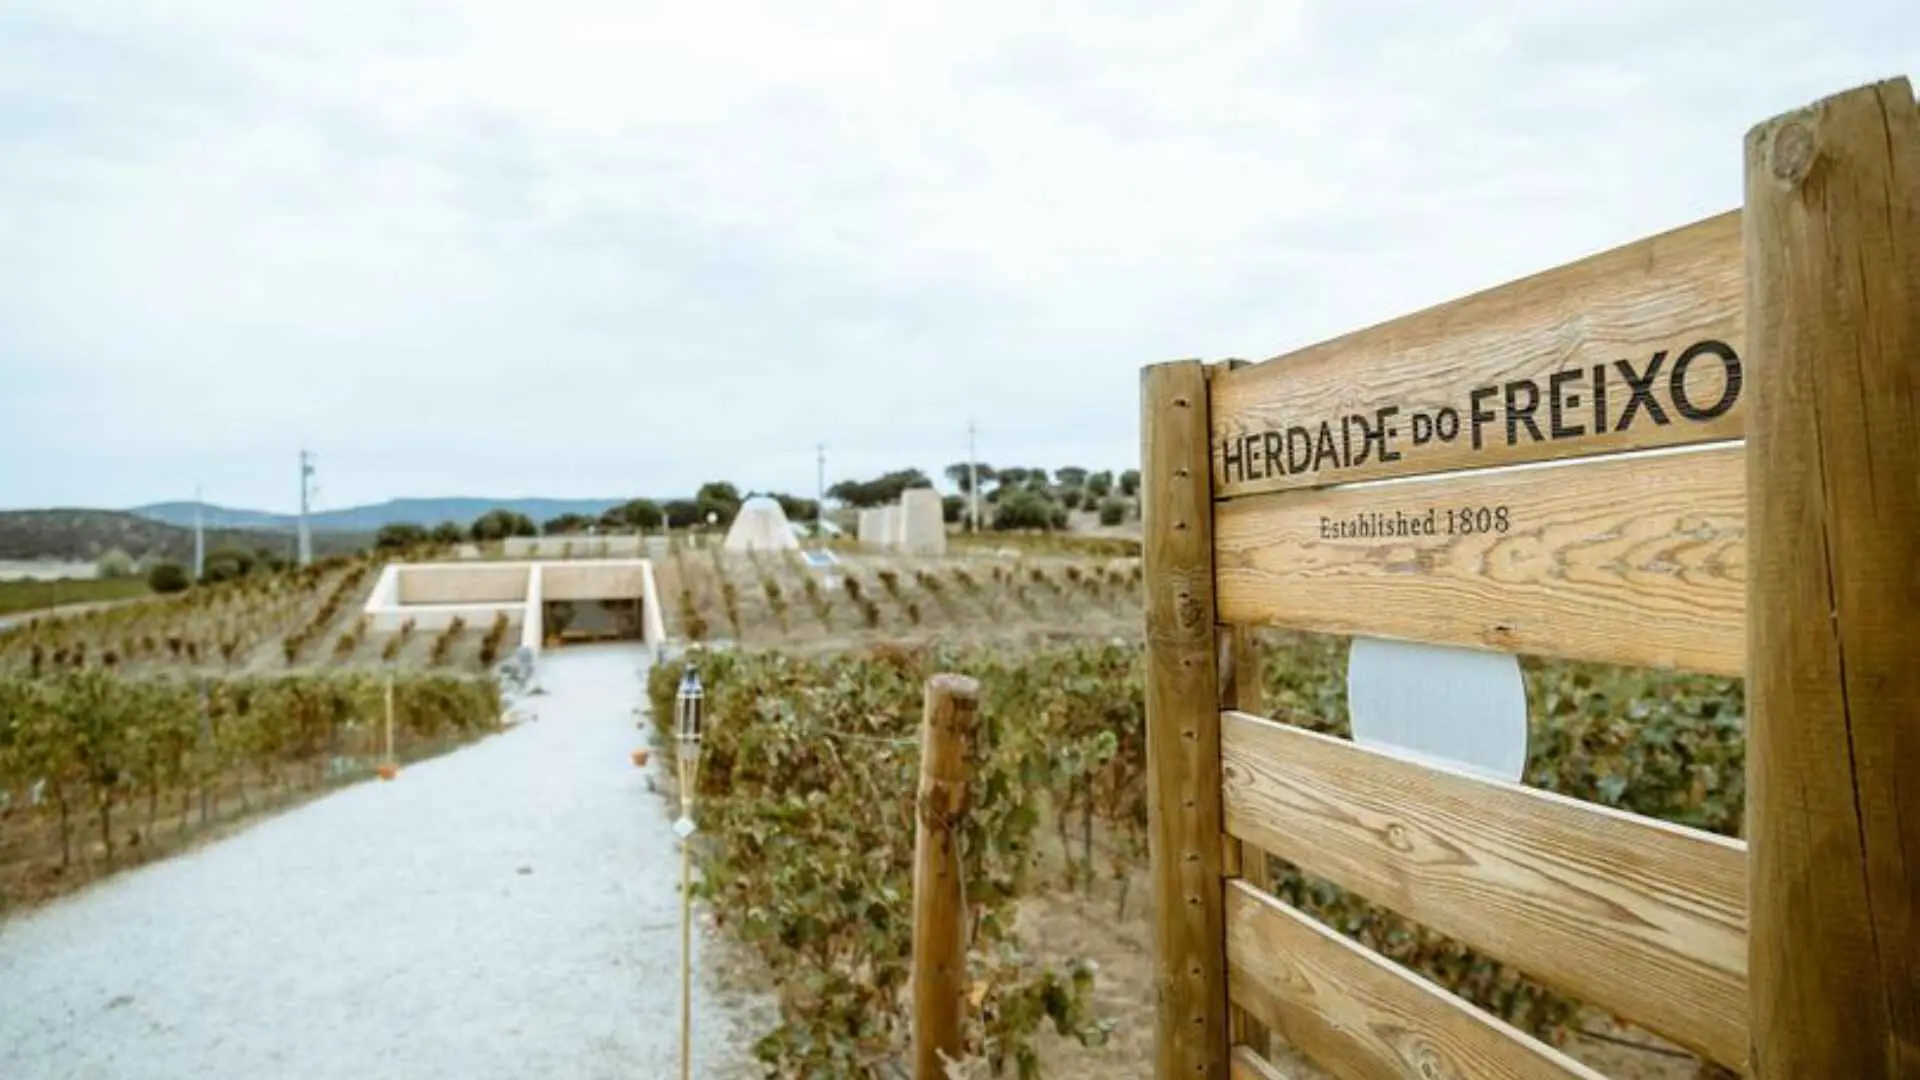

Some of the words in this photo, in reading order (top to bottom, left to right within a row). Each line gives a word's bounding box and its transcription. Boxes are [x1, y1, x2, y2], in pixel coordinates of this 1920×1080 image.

[1223, 406, 1401, 484] HERDADE
[1412, 407, 1460, 445] DO
[1470, 339, 1743, 450] FREIXO
[1319, 508, 1436, 539] Established
[1446, 506, 1510, 535] 1808
